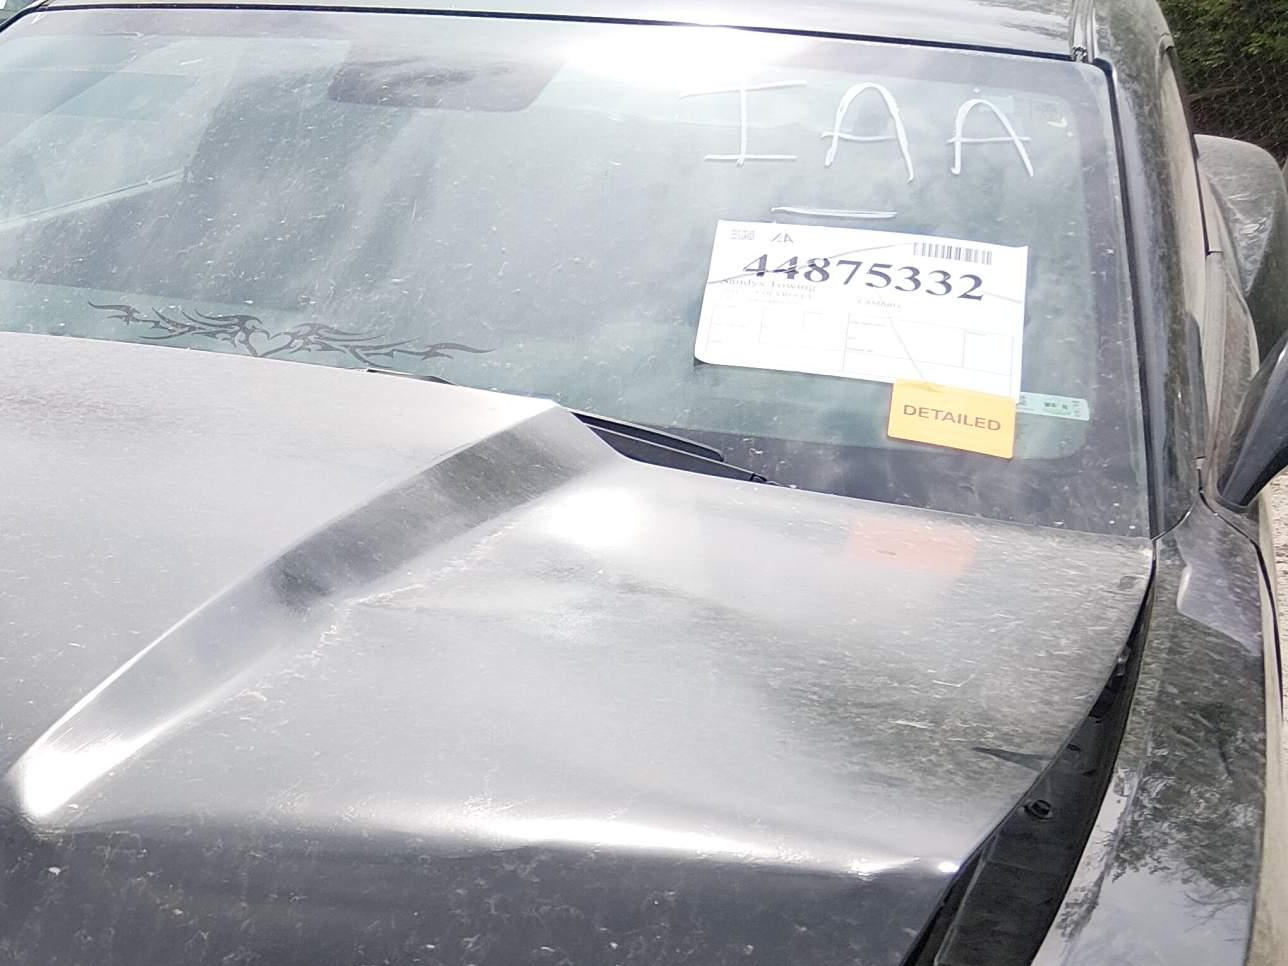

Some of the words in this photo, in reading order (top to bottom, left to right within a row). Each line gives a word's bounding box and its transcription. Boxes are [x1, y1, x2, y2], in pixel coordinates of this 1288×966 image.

[680, 80, 1035, 183] IAA
[743, 252, 984, 302] 44875332
[903, 403, 1002, 433] DETAILED
